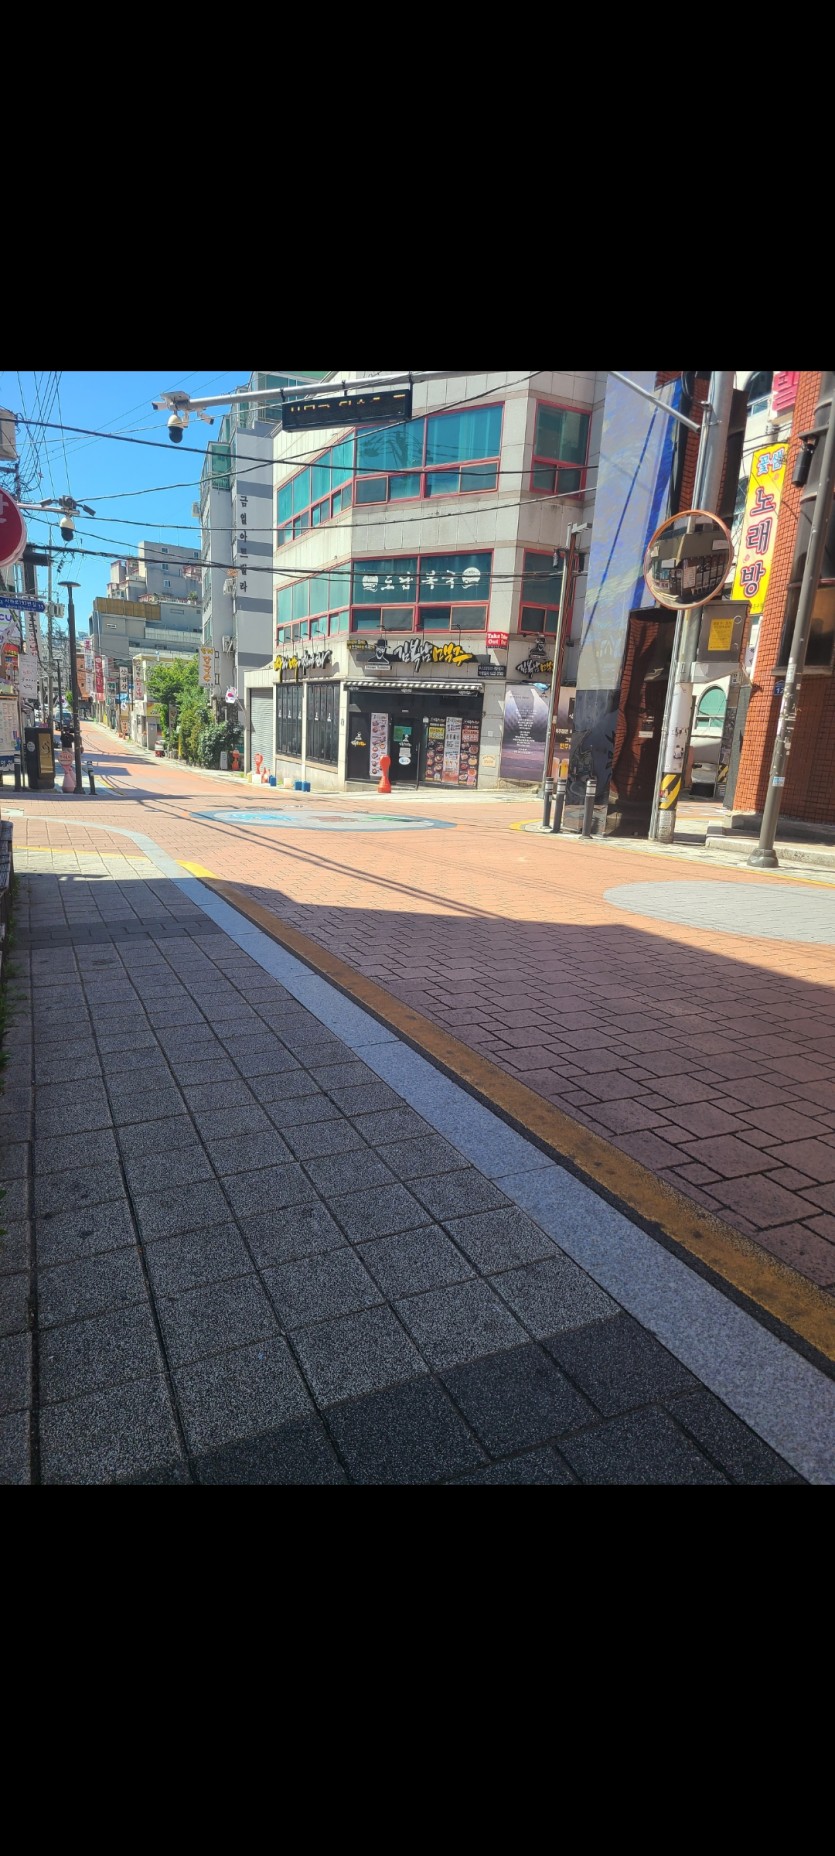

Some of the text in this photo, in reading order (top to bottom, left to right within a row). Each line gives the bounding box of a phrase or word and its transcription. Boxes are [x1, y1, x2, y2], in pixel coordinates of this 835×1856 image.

[739, 486, 777, 599] 노래방
[393, 637, 474, 673] 김복남맥주
[516, 659, 554, 678] 김복남맥
